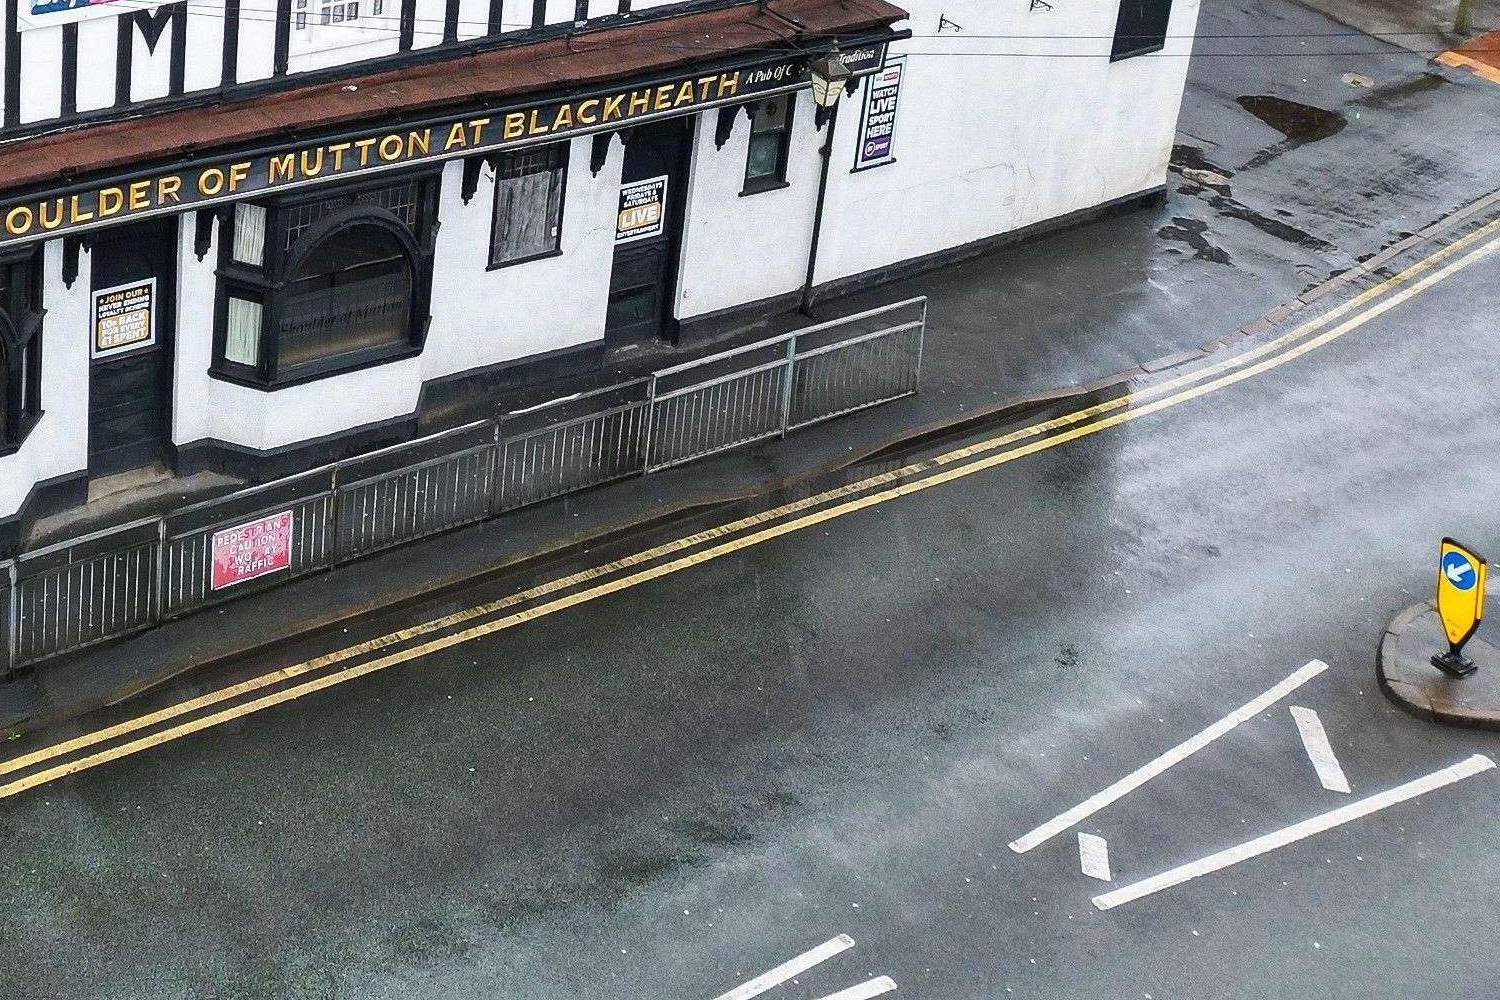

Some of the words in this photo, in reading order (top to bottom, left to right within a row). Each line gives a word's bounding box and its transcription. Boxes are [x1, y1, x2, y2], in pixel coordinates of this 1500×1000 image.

[746, 73, 753, 85] A
[755, 68, 772, 83] Pub
[773, 65, 785, 81] Of
[872, 86, 897, 99] WATCH
[870, 96, 896, 114] LIVE
[869, 112, 894, 126] SPORT
[198, 161, 251, 199] OF
[267, 127, 431, 186] MUTTON
[445, 118, 490, 150] AT
[504, 72, 740, 140] BLACKHEATH
[866, 122, 892, 138] HERE
[622, 206, 658, 228] LIVE
[104, 293, 124, 304] JOIN
[125, 288, 143, 298] OUR
[119, 312, 145, 324] BACK
